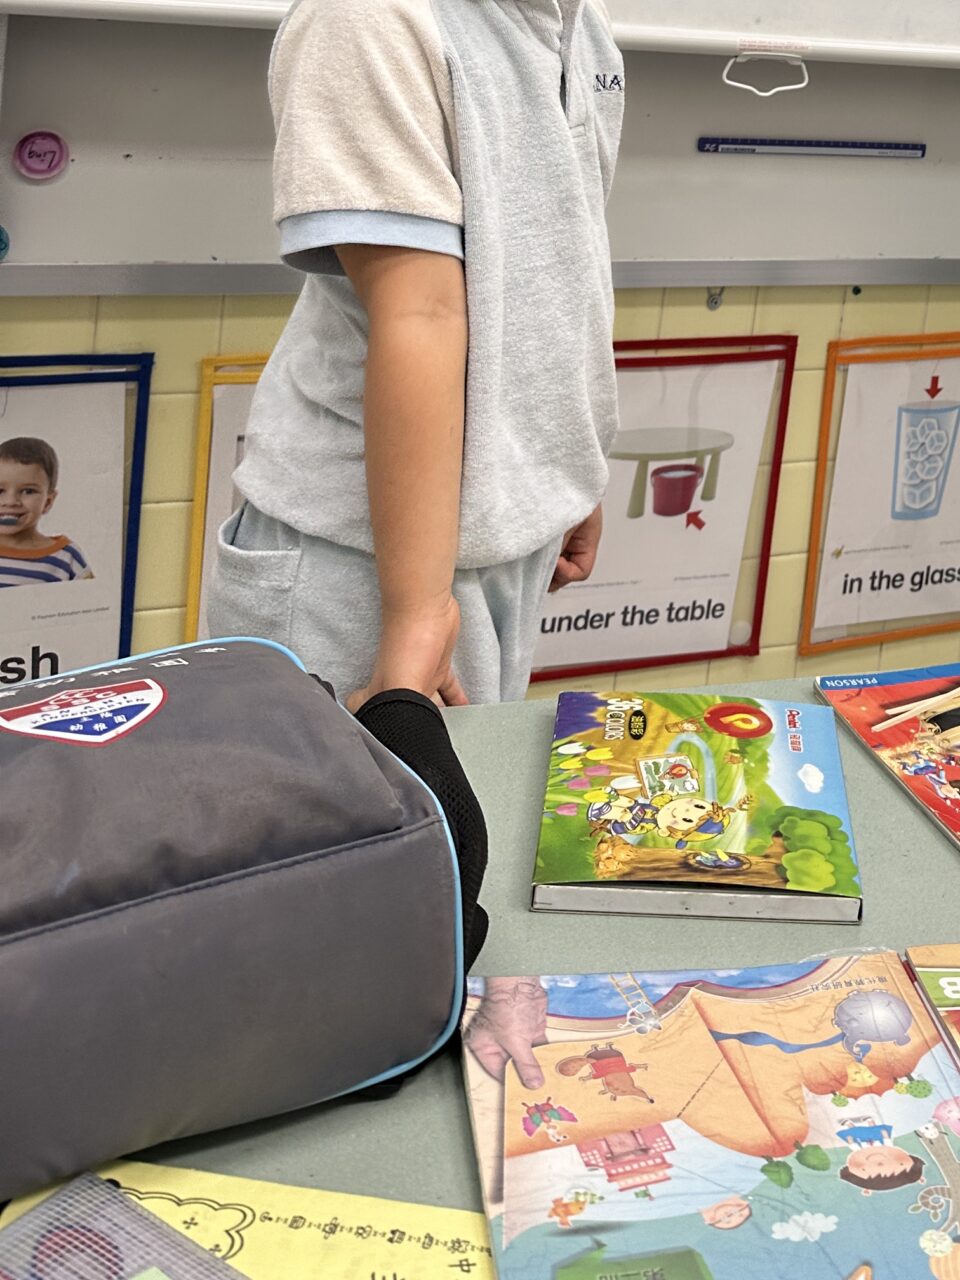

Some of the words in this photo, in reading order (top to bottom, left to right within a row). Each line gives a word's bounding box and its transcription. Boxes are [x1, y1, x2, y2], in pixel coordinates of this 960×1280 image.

[841, 572, 866, 596] in
[869, 568, 905, 592] the
[540, 608, 616, 635] under
[619, 604, 661, 628] the
[666, 598, 726, 624] table
[825, 674, 880, 689] PEARSON
[606, 697, 644, 714] 36
